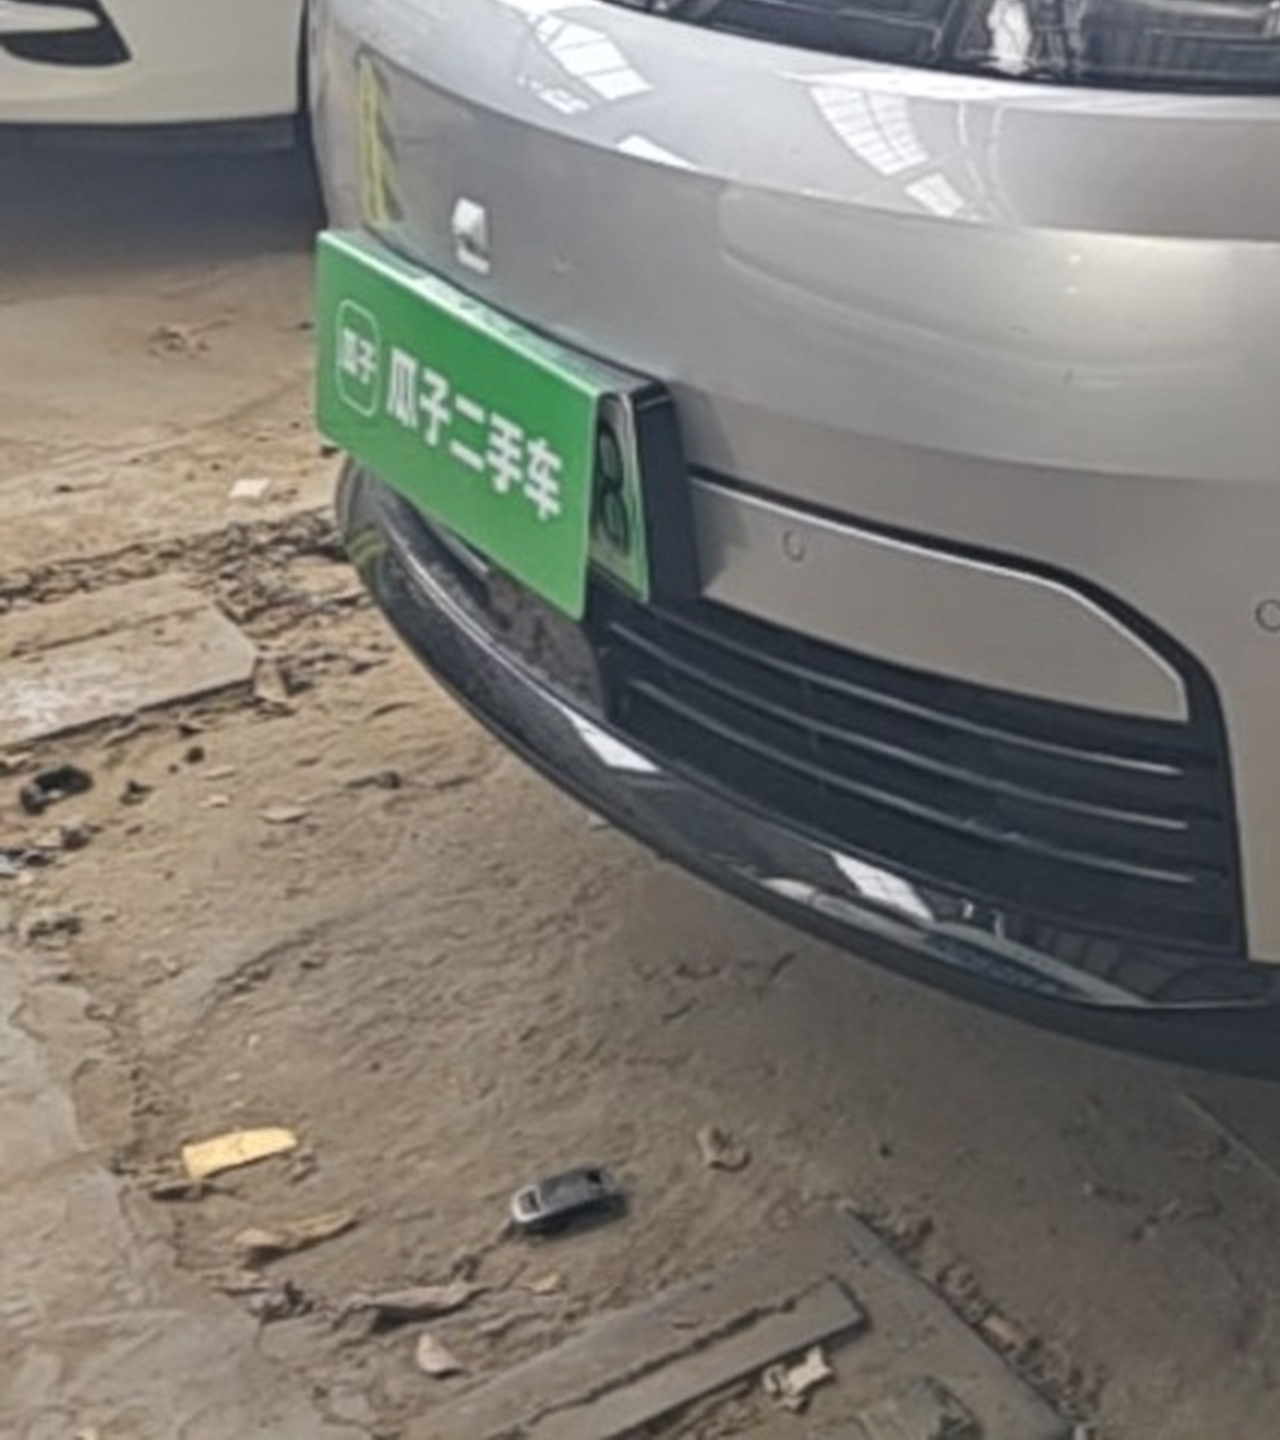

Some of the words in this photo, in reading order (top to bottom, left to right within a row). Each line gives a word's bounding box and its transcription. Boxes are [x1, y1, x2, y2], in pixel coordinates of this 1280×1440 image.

[386, 345, 563, 522] 瓜子二手车
